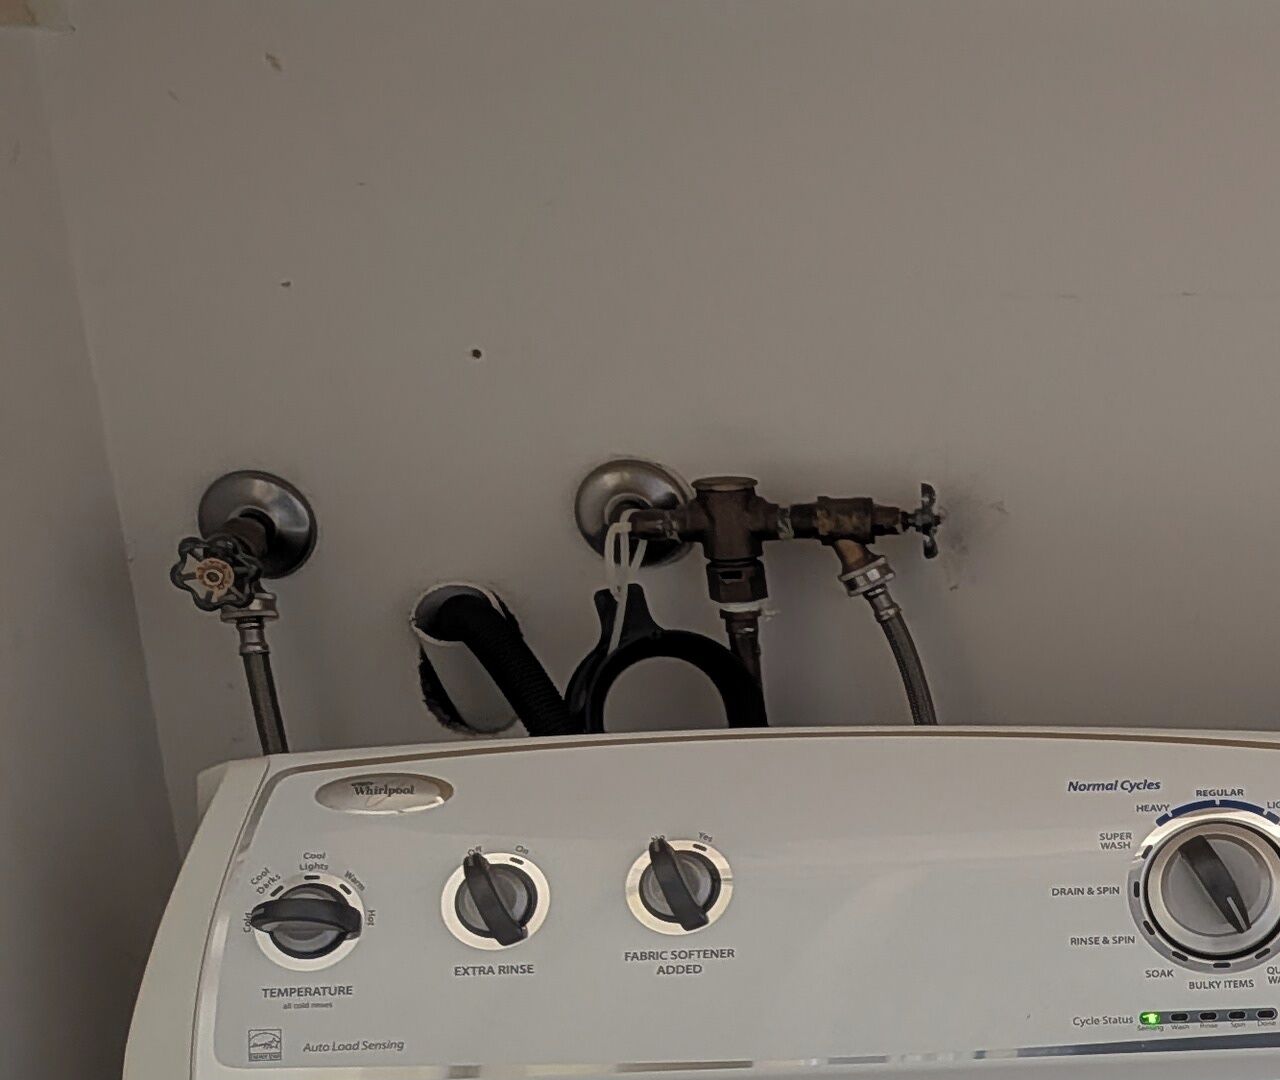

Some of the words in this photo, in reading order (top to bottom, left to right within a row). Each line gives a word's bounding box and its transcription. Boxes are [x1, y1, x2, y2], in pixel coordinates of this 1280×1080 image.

[352, 781, 415, 798] Whirlpool
[1068, 780, 1117, 792] Normal
[1120, 779, 1161, 793] Cycles
[1195, 788, 1244, 797] REGULAR
[1136, 804, 1170, 812] HEAVY
[699, 831, 713, 843] Yes
[1100, 832, 1132, 840] SUPER
[515, 844, 528, 855] On
[1100, 841, 1131, 850] WASH
[303, 852, 326, 860] Cool
[299, 862, 329, 872] Lights
[251, 867, 270, 885] Cool
[344, 870, 365, 891] Warm
[256, 874, 281, 895] Darks
[1052, 888, 1085, 896] DRAIN
[1087, 887, 1095, 895] &
[1096, 886, 1120, 895] SPIN
[367, 909, 376, 926] Hot
[1070, 937, 1100, 945] RINSE
[1102, 936, 1110, 945] &
[1112, 935, 1136, 944] SPIN
[624, 951, 667, 962] FABRIC
[670, 949, 735, 960] SOFTENER
[454, 966, 495, 977] EXTRA
[498, 964, 534, 975] RINSE
[656, 964, 702, 975] ADDED
[1145, 969, 1174, 978] SOAK
[1188, 981, 1221, 990] BULKY
[1224, 979, 1254, 989] ITEMS
[262, 985, 353, 998] TEMPERATURE
[1072, 1017, 1099, 1028] Cycle
[1102, 1015, 1134, 1025] Status
[303, 1042, 330, 1052] Auto
[332, 1041, 359, 1051] Load
[361, 1040, 404, 1053] Sensing
